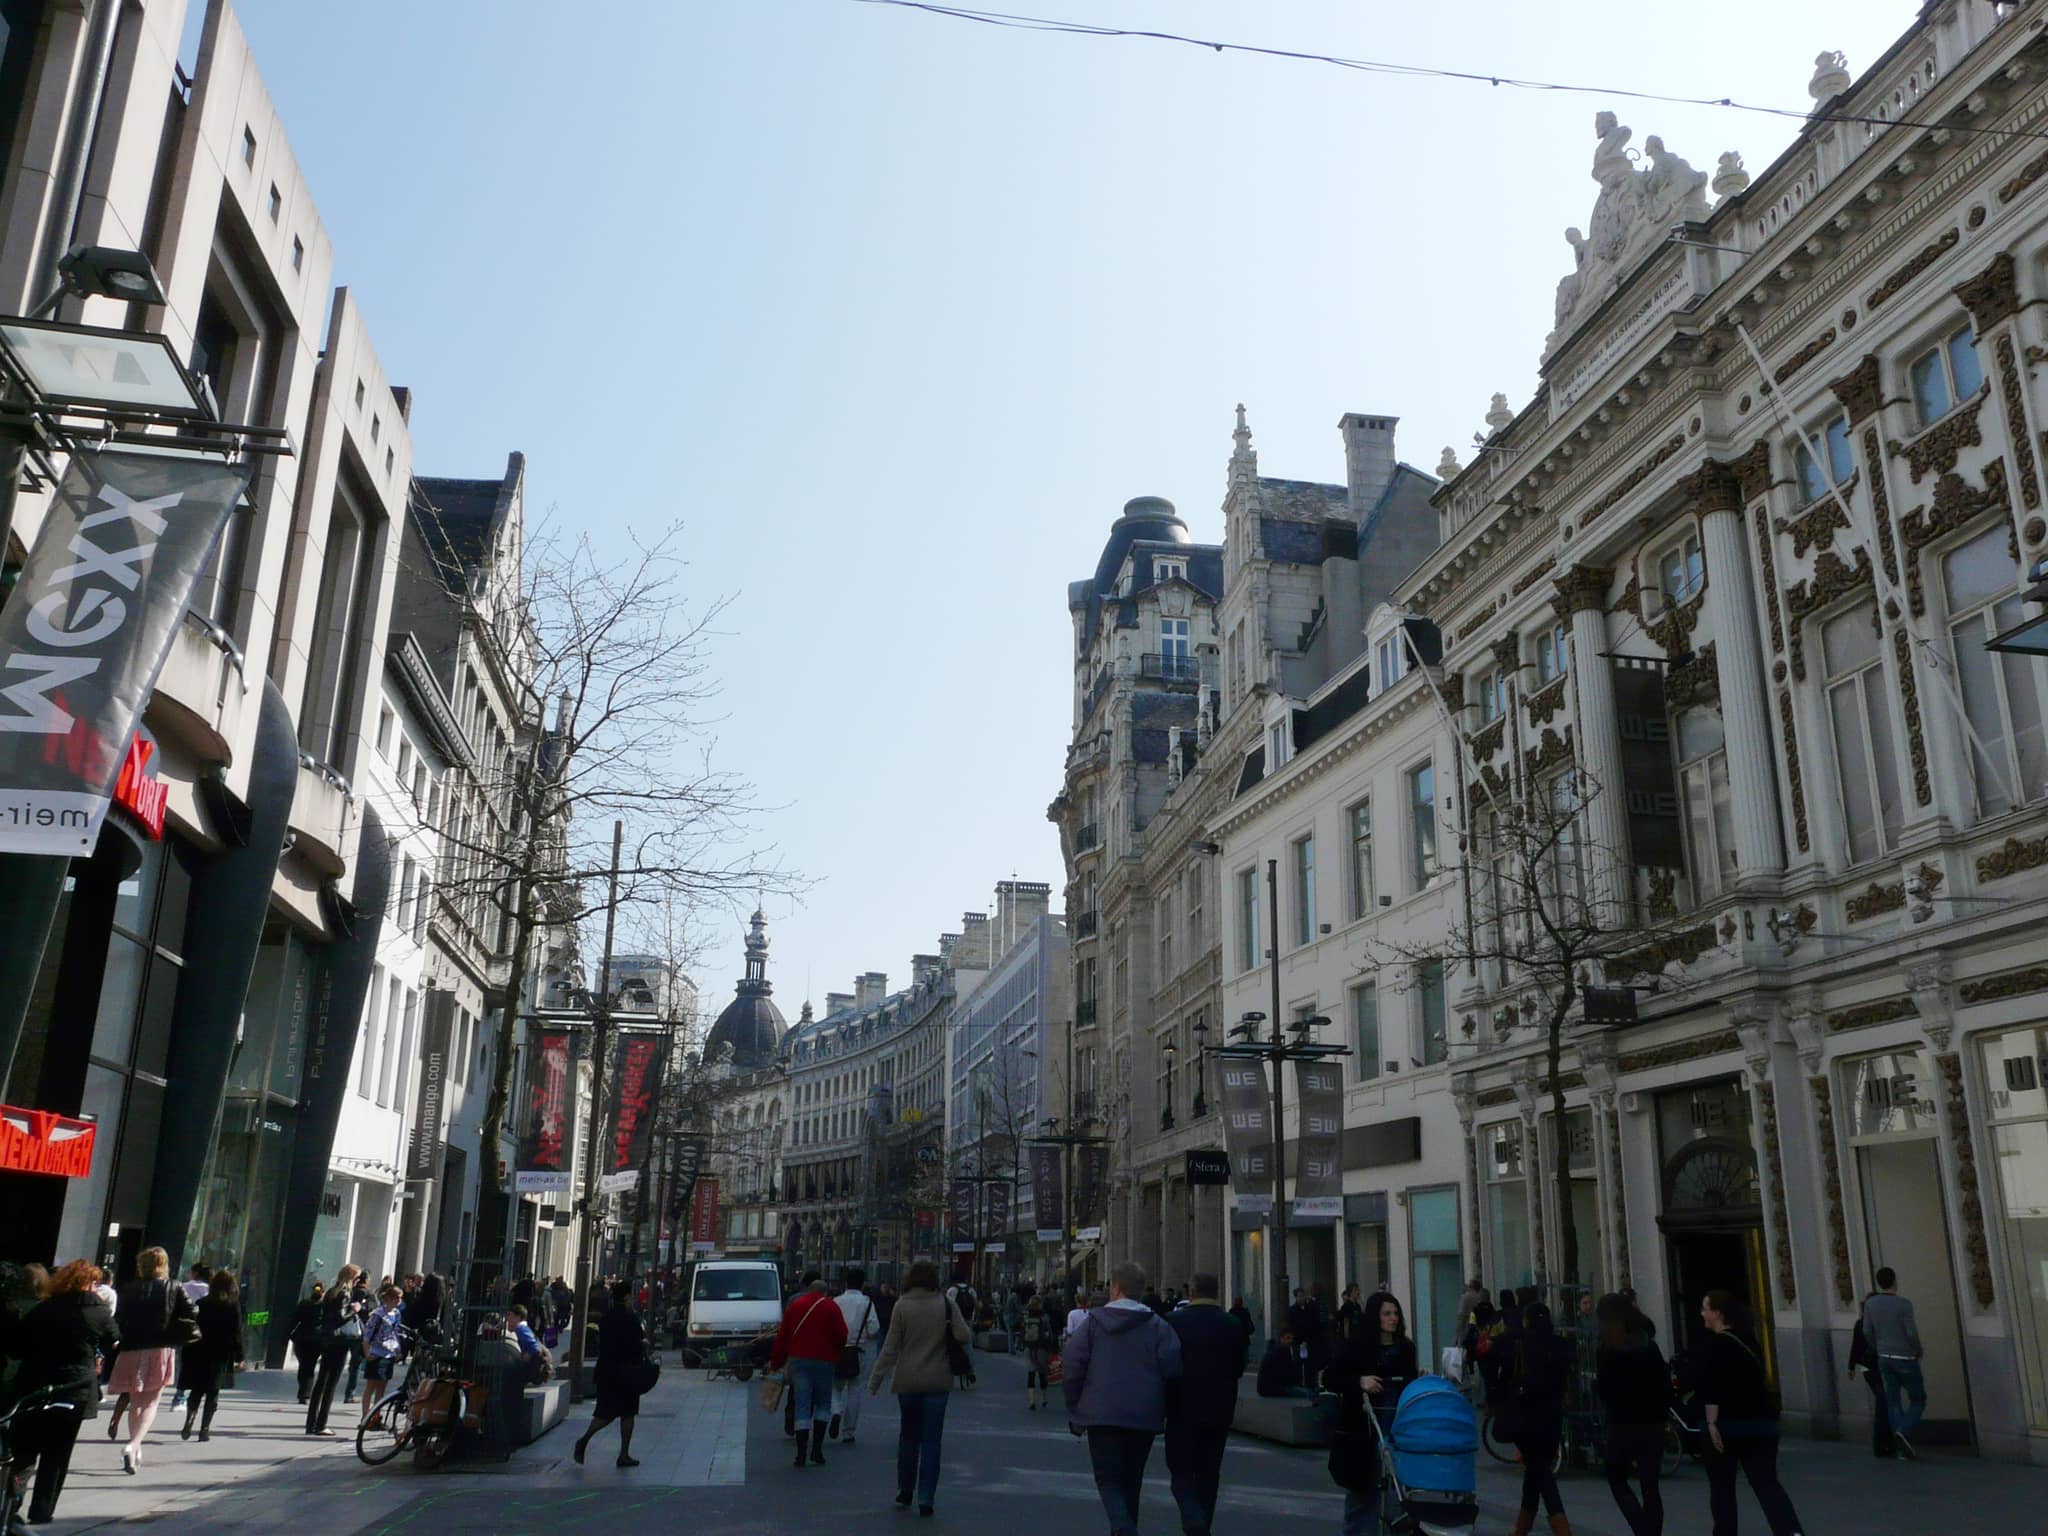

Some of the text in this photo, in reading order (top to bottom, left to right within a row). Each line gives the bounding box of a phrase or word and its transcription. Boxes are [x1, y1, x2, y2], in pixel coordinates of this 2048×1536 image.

[1226, 1071, 1257, 1086] WE
[1864, 1073, 1917, 1109] WE
[418, 1051, 442, 1170] www.mango.com
[1231, 1112, 1263, 1129] WE
